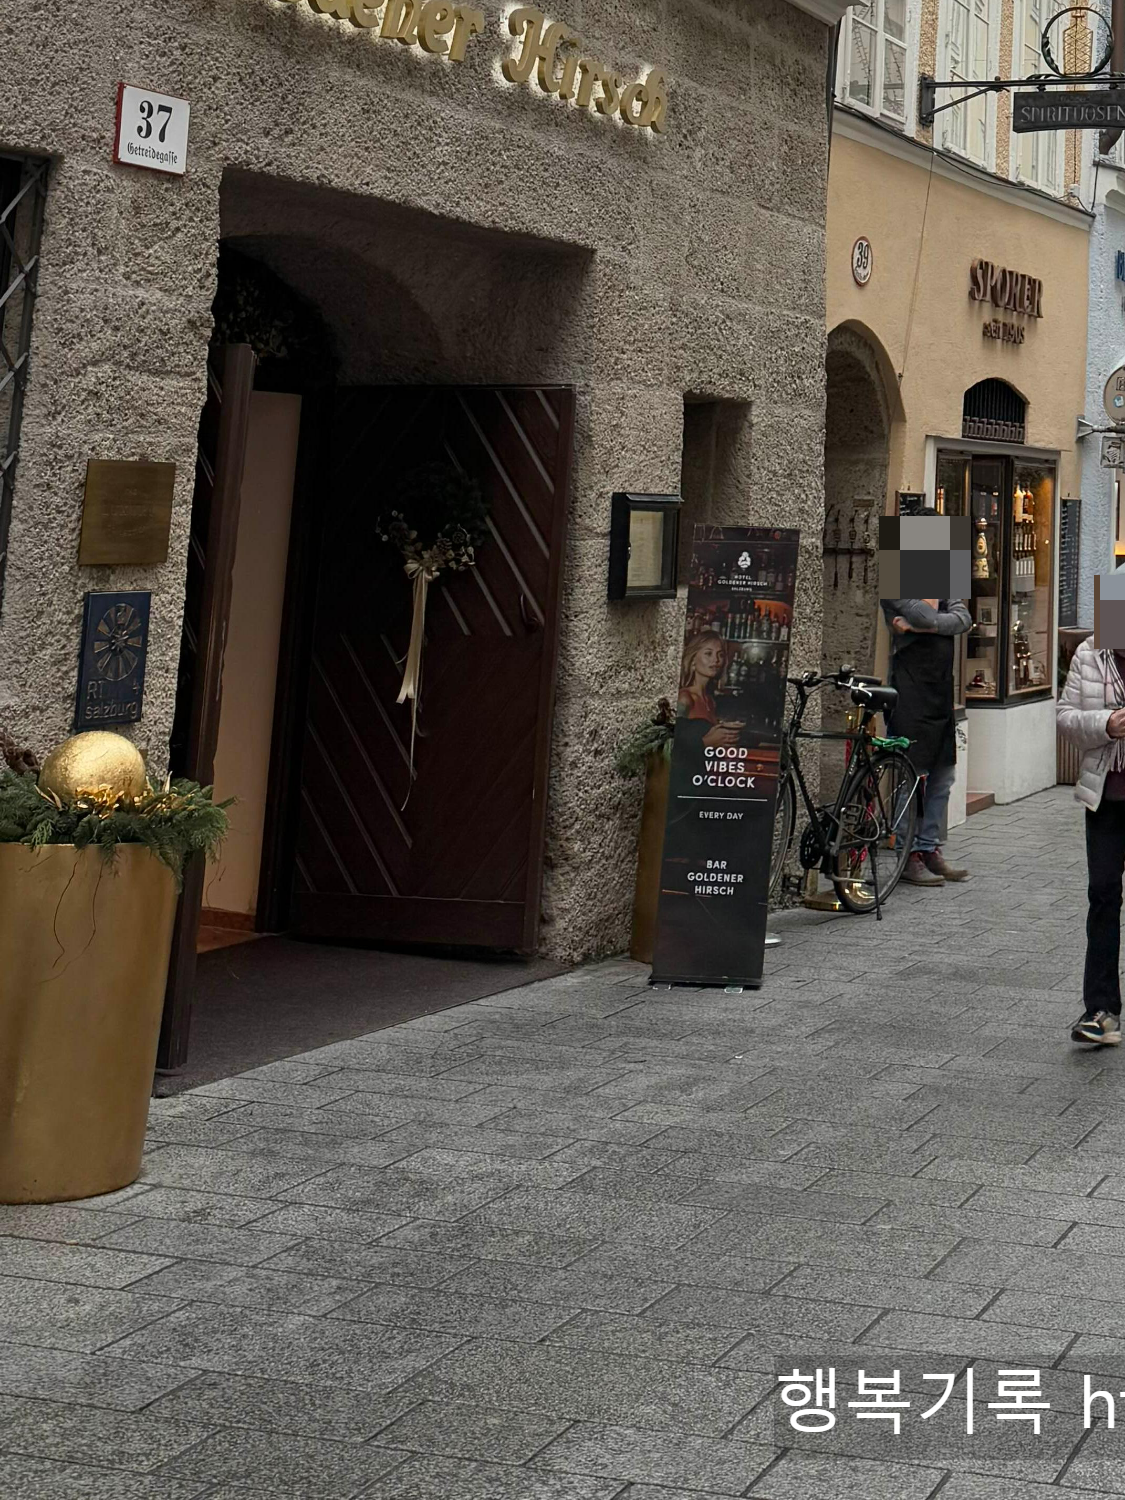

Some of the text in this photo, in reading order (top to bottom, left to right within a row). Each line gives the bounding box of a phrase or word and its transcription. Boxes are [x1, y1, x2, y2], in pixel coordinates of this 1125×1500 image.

[501, 7, 668, 134] Hirsch
[137, 100, 173, 143] 37
[857, 241, 870, 269] 39
[968, 258, 1043, 318] SPORER
[704, 746, 748, 759] GOOD
[705, 761, 745, 773] VIBES
[692, 775, 755, 788] O'CLOCK
[699, 811, 743, 820] EVERY DAY
[706, 860, 727, 870] BAR
[687, 872, 744, 883] GOLDENER
[694, 885, 734, 895] HIRSCH
